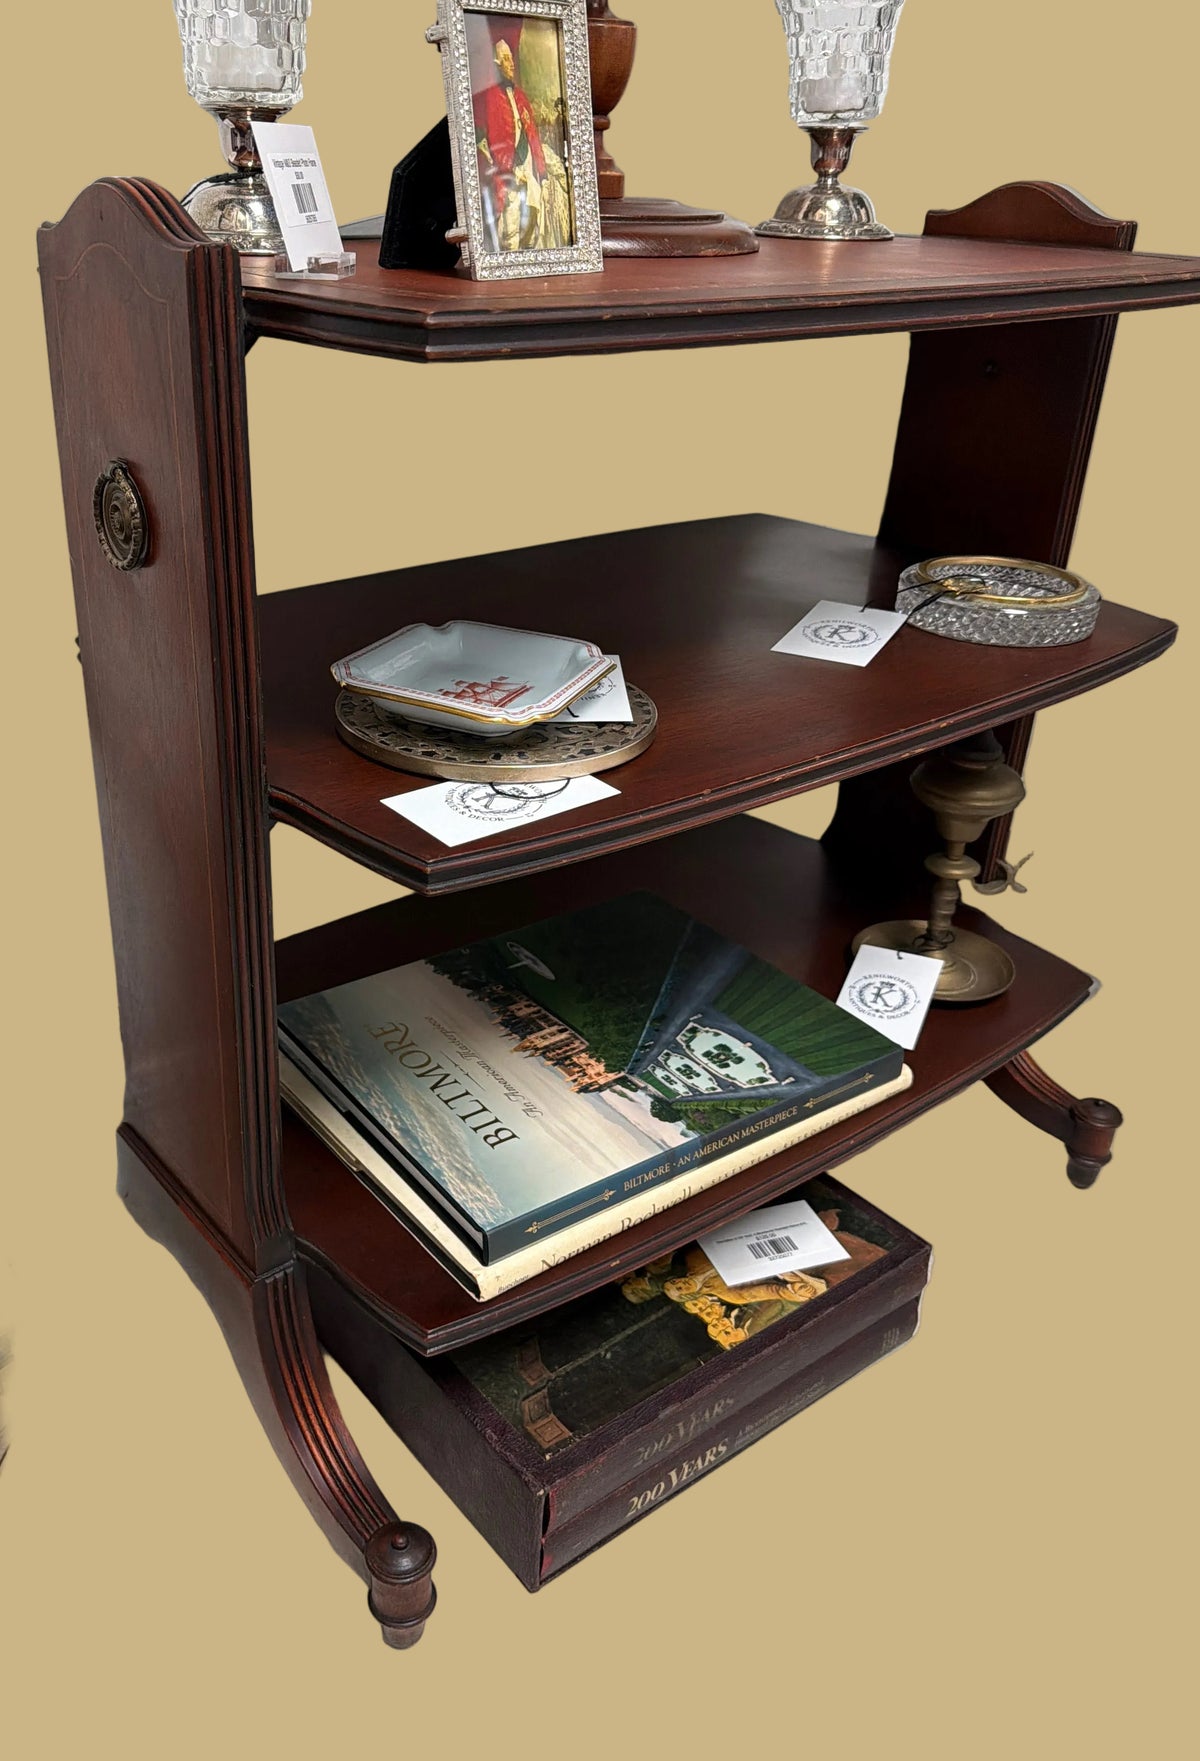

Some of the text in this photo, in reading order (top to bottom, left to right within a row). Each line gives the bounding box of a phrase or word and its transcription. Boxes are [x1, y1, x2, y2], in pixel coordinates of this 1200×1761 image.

[468, 813, 505, 822] DECOR
[863, 973, 915, 989] KENILWORTH
[869, 986, 898, 1008] K
[886, 1010, 911, 1020] DECOR
[369, 1021, 521, 1150] BILTMORE
[424, 1015, 544, 1118] An American Masterpiece
[623, 1106, 799, 1192] BILTMORE AN AMERICAN MASTERPIECE
[541, 1232, 612, 1272] Norman
[620, 1186, 692, 1232] Rockwell
[632, 1434, 673, 1468] 200
[675, 1398, 735, 1442] YEARS
[625, 1437, 729, 1518] 200 YEARS
